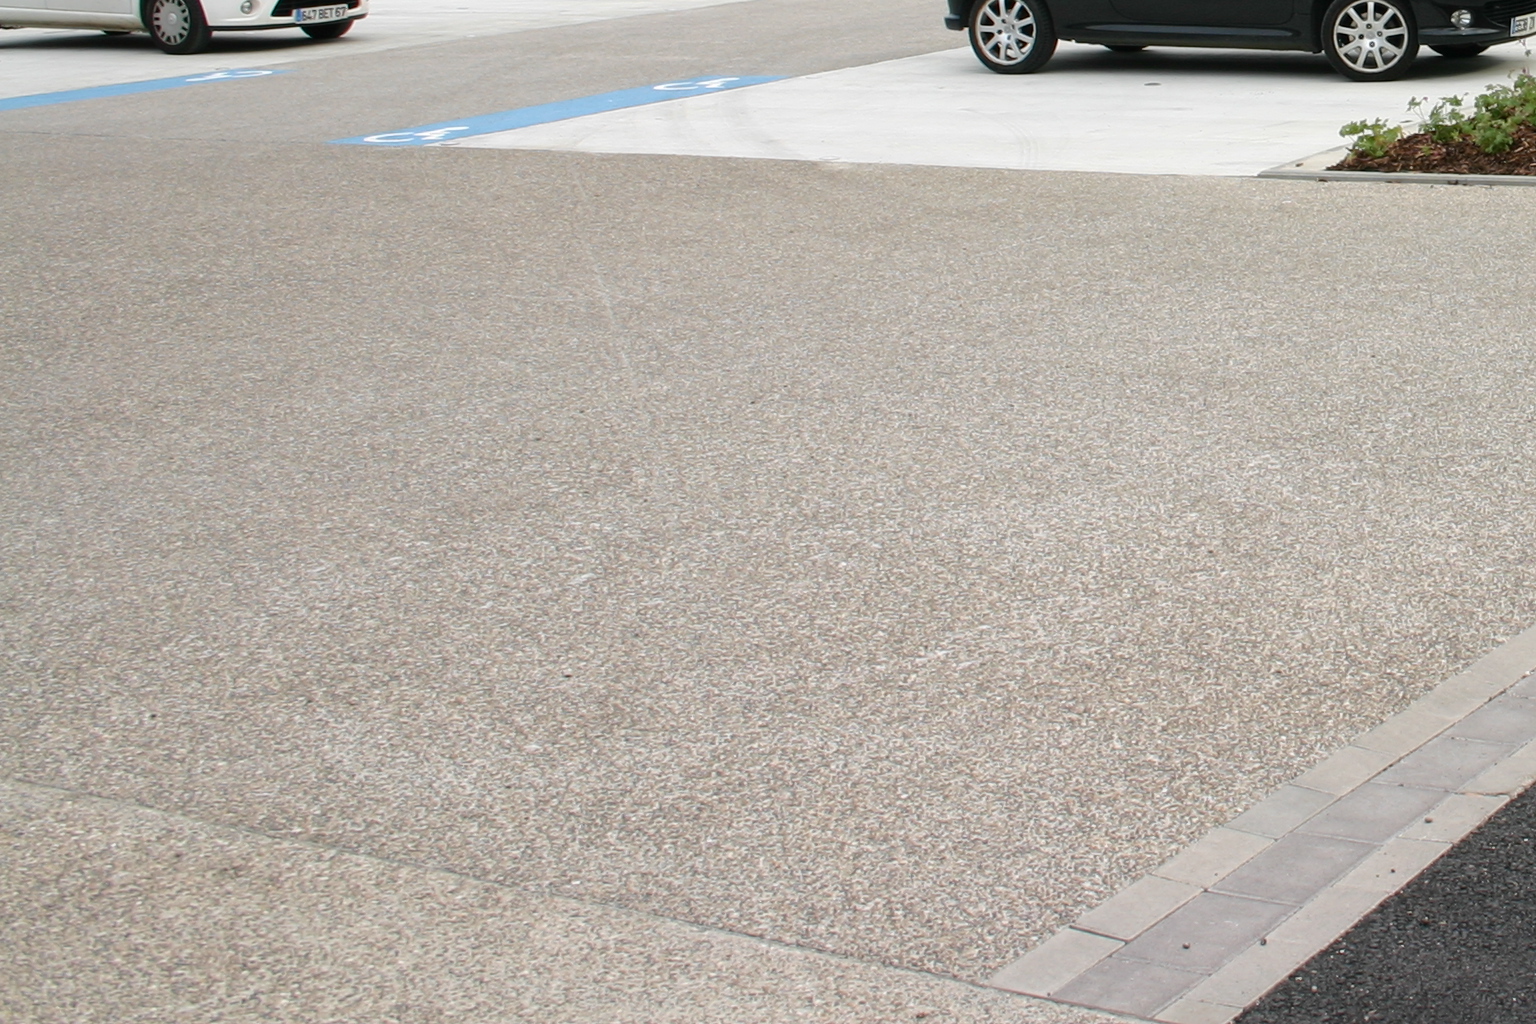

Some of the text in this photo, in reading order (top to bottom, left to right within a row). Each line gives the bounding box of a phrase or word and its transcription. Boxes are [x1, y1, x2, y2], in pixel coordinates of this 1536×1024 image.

[302, 6, 347, 21] 647 BET 67
